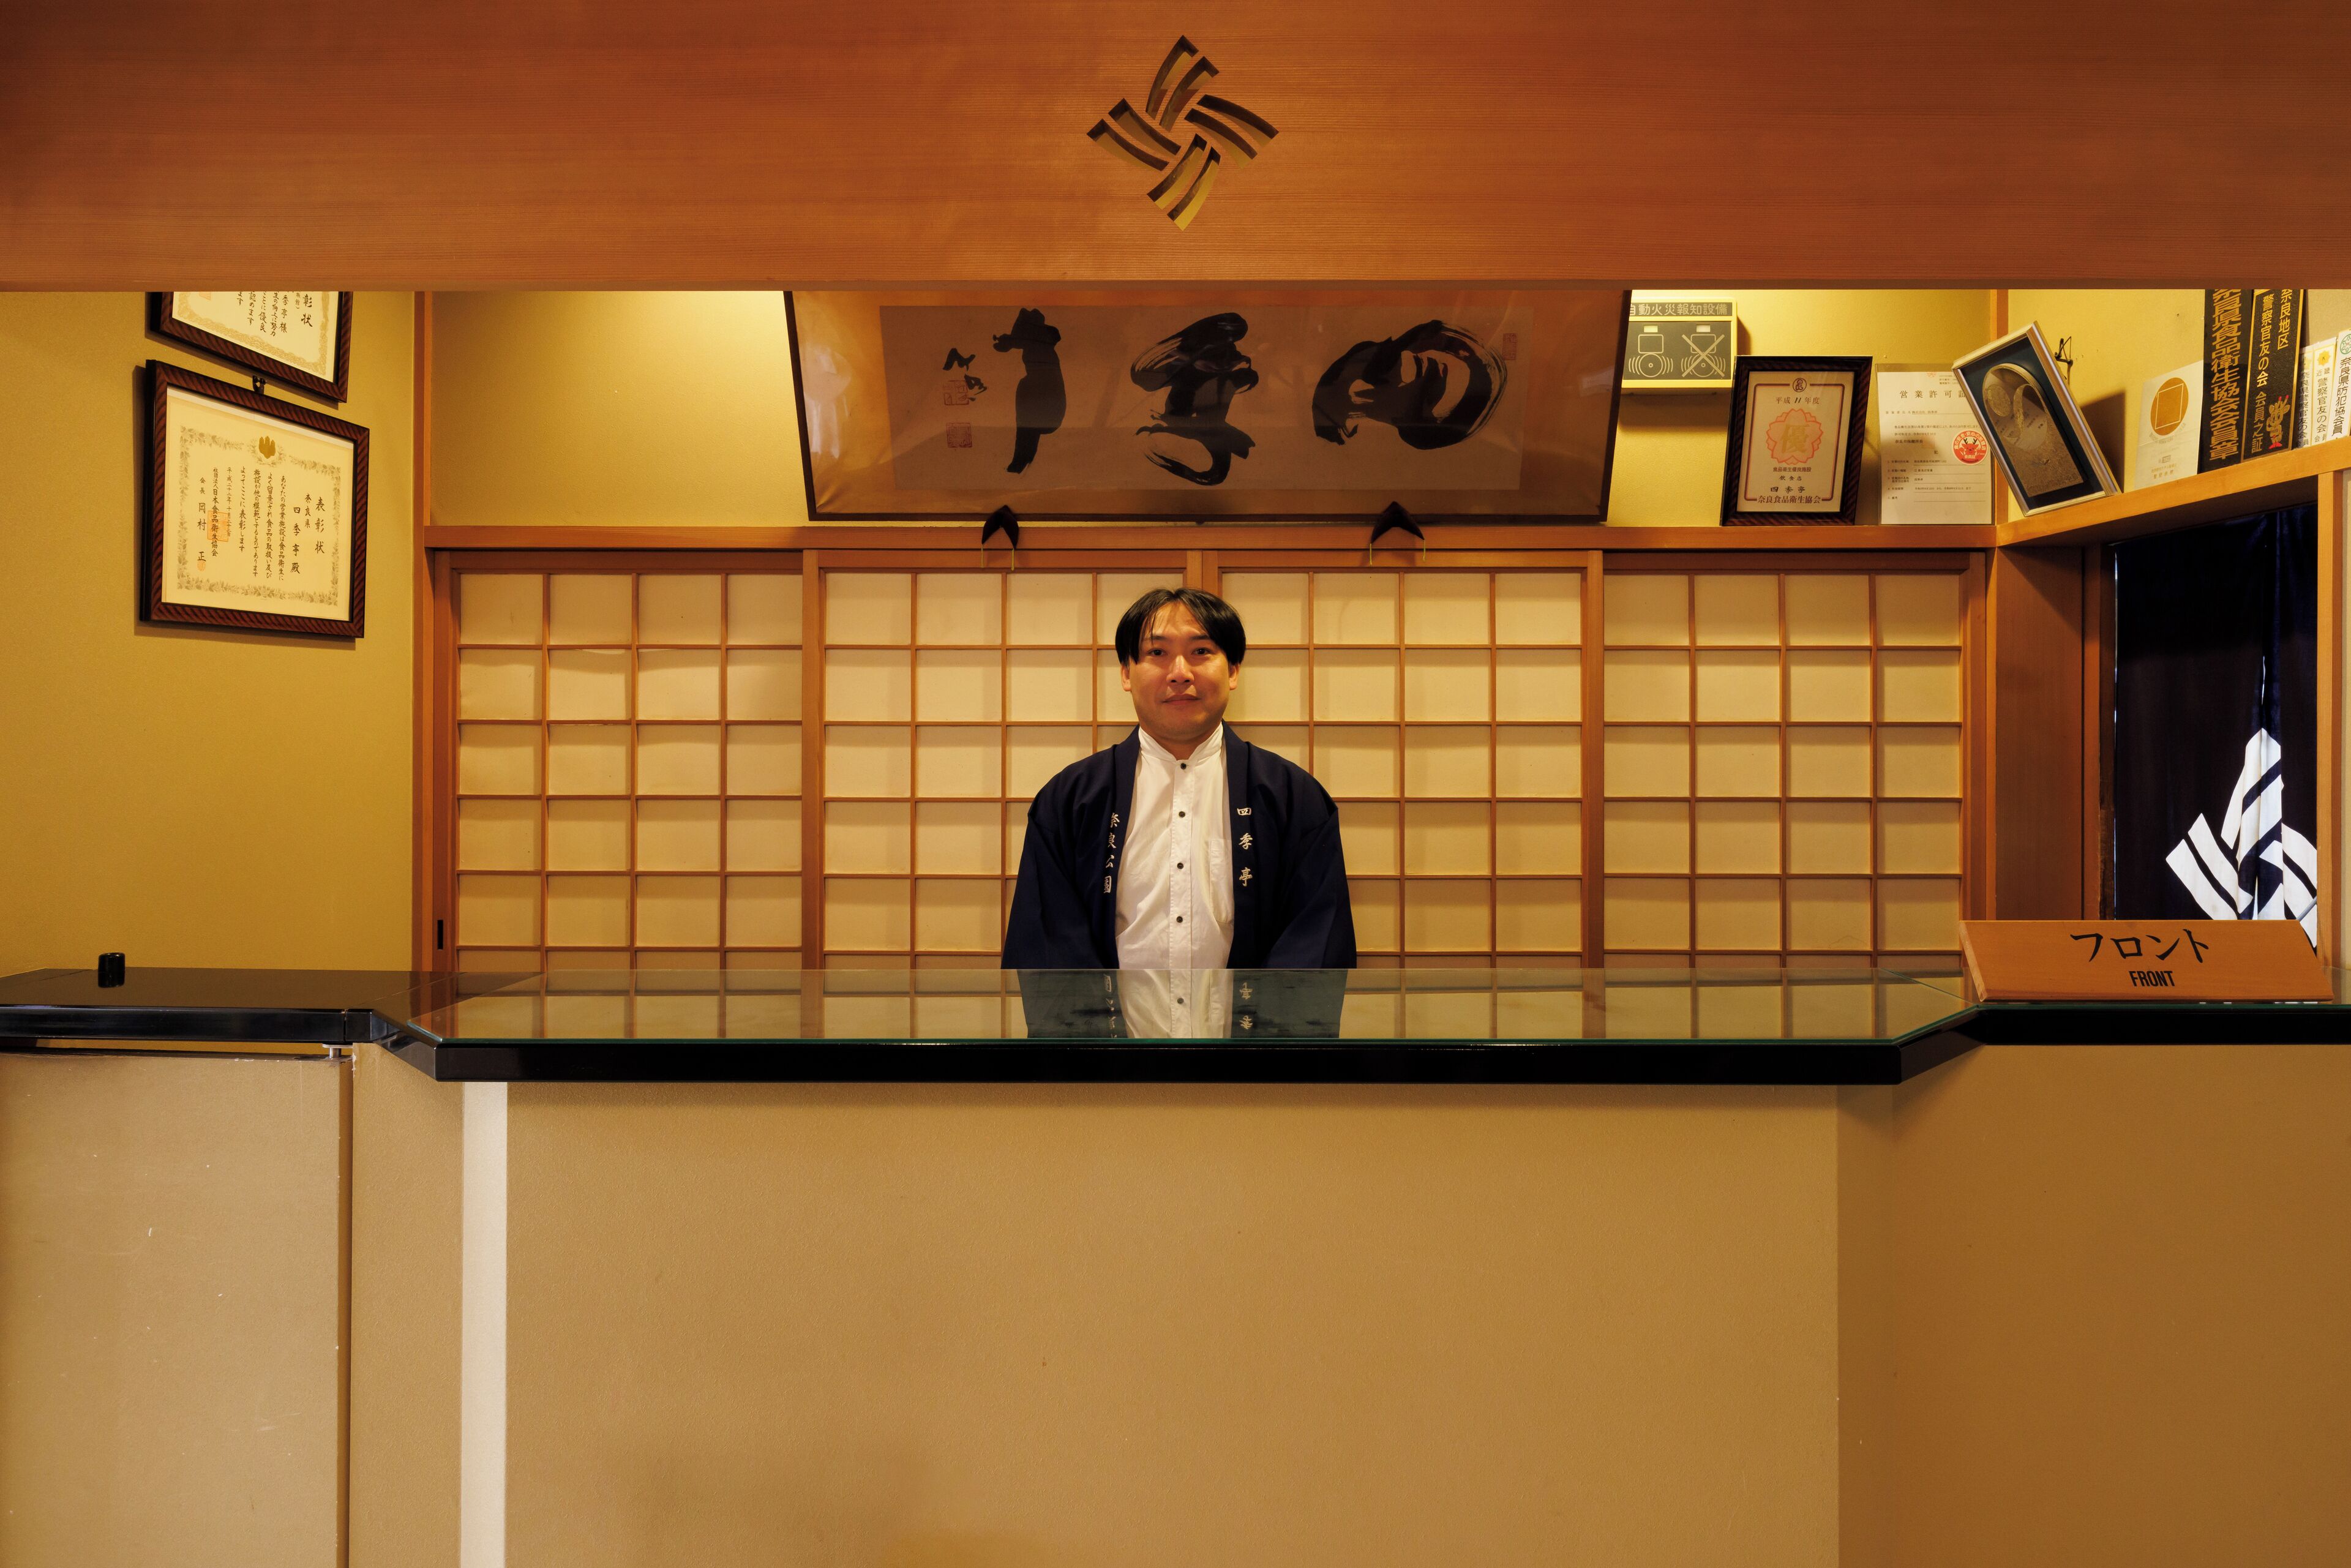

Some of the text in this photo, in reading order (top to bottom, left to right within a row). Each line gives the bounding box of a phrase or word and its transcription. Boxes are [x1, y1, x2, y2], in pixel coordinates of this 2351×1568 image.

[279, 291, 293, 333] 季亭様
[2251, 294, 2275, 454] 警察官友の会 会員之証
[2317, 378, 2328, 433] 警察官友の会
[200, 477, 206, 495] 会長
[1758, 495, 1821, 504] 奈良食品衛生協会
[290, 507, 301, 574] 四季亭殿
[315, 497, 326, 554] 表彰状
[1237, 807, 1253, 887] 四季亭
[2070, 929, 2209, 963] フロント
[2129, 970, 2175, 987] FRONT
